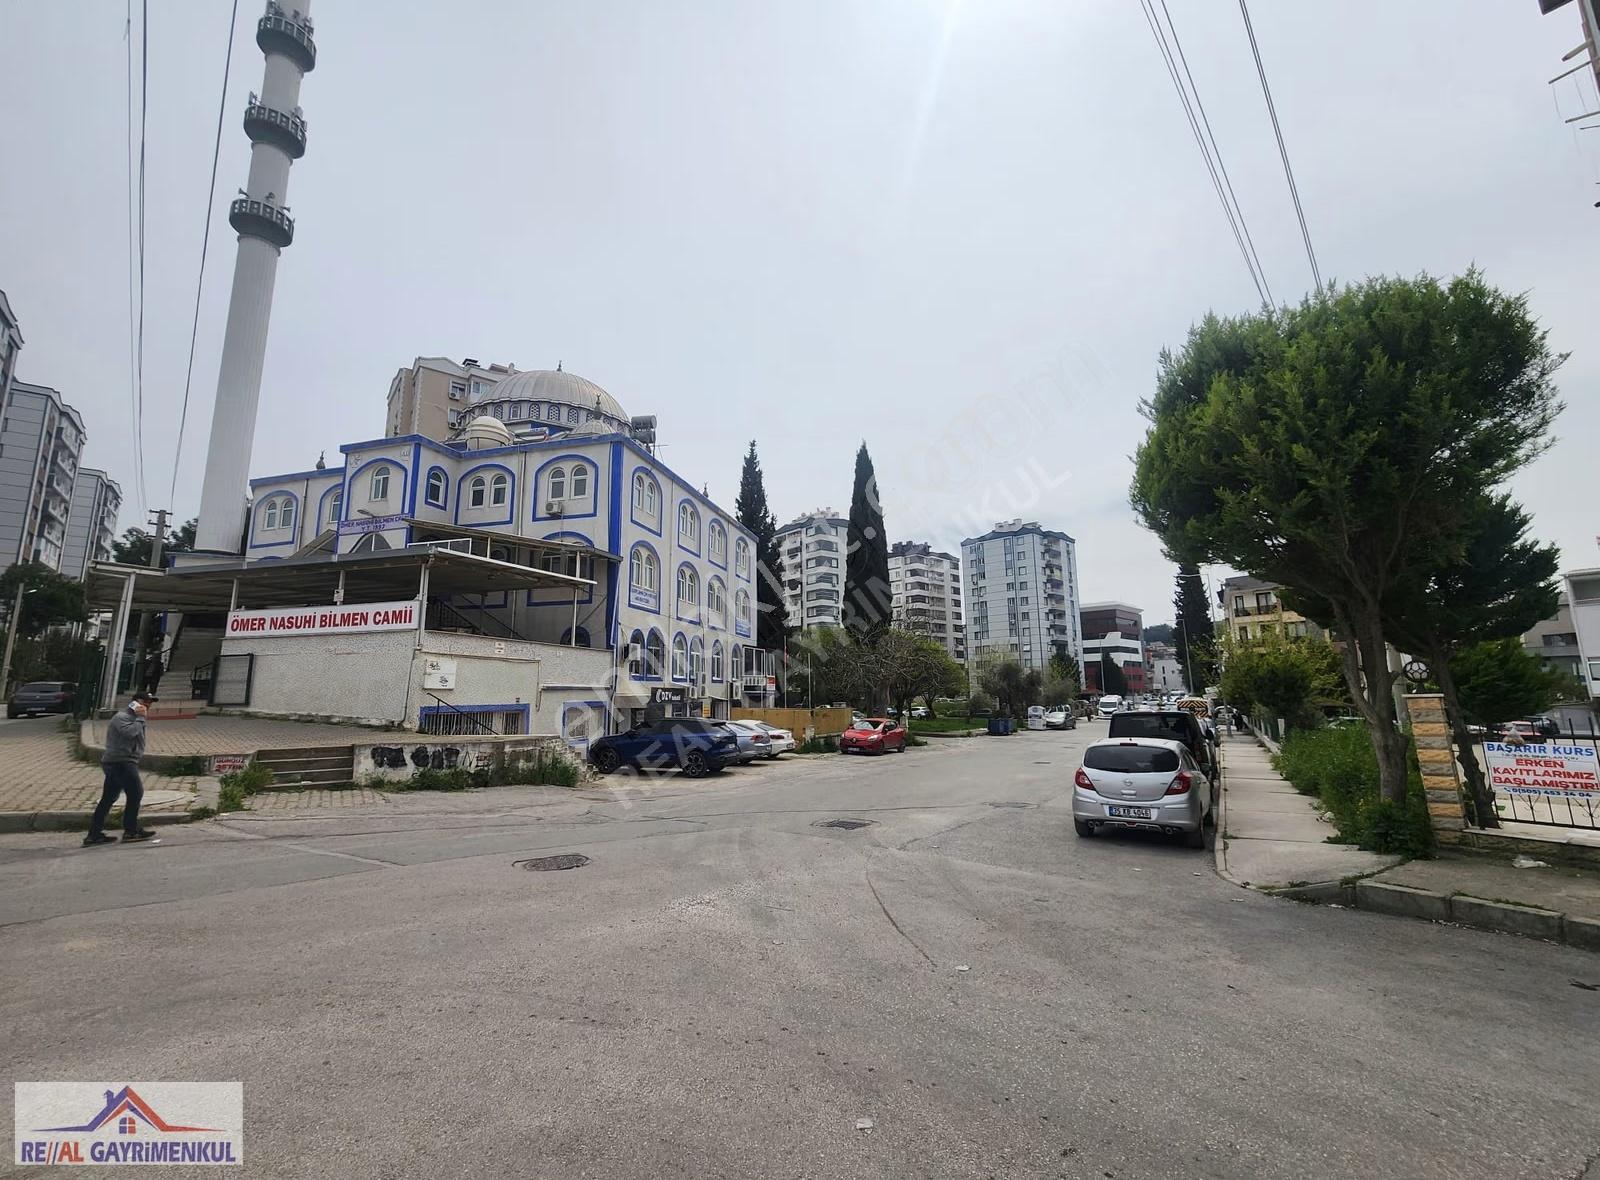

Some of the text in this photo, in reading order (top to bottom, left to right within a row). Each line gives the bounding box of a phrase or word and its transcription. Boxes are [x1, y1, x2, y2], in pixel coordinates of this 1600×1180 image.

[231, 606, 413, 632] ÖMER NASUHİ BİLMEN CAMİİ
[1487, 743, 1594, 757] BAŞARIR KURS
[1515, 758, 1565, 769] ERKEN
[1492, 766, 1596, 780] KAYITLARIMIZ
[1493, 776, 1600, 791] BAŞLAMIŞTIR!
